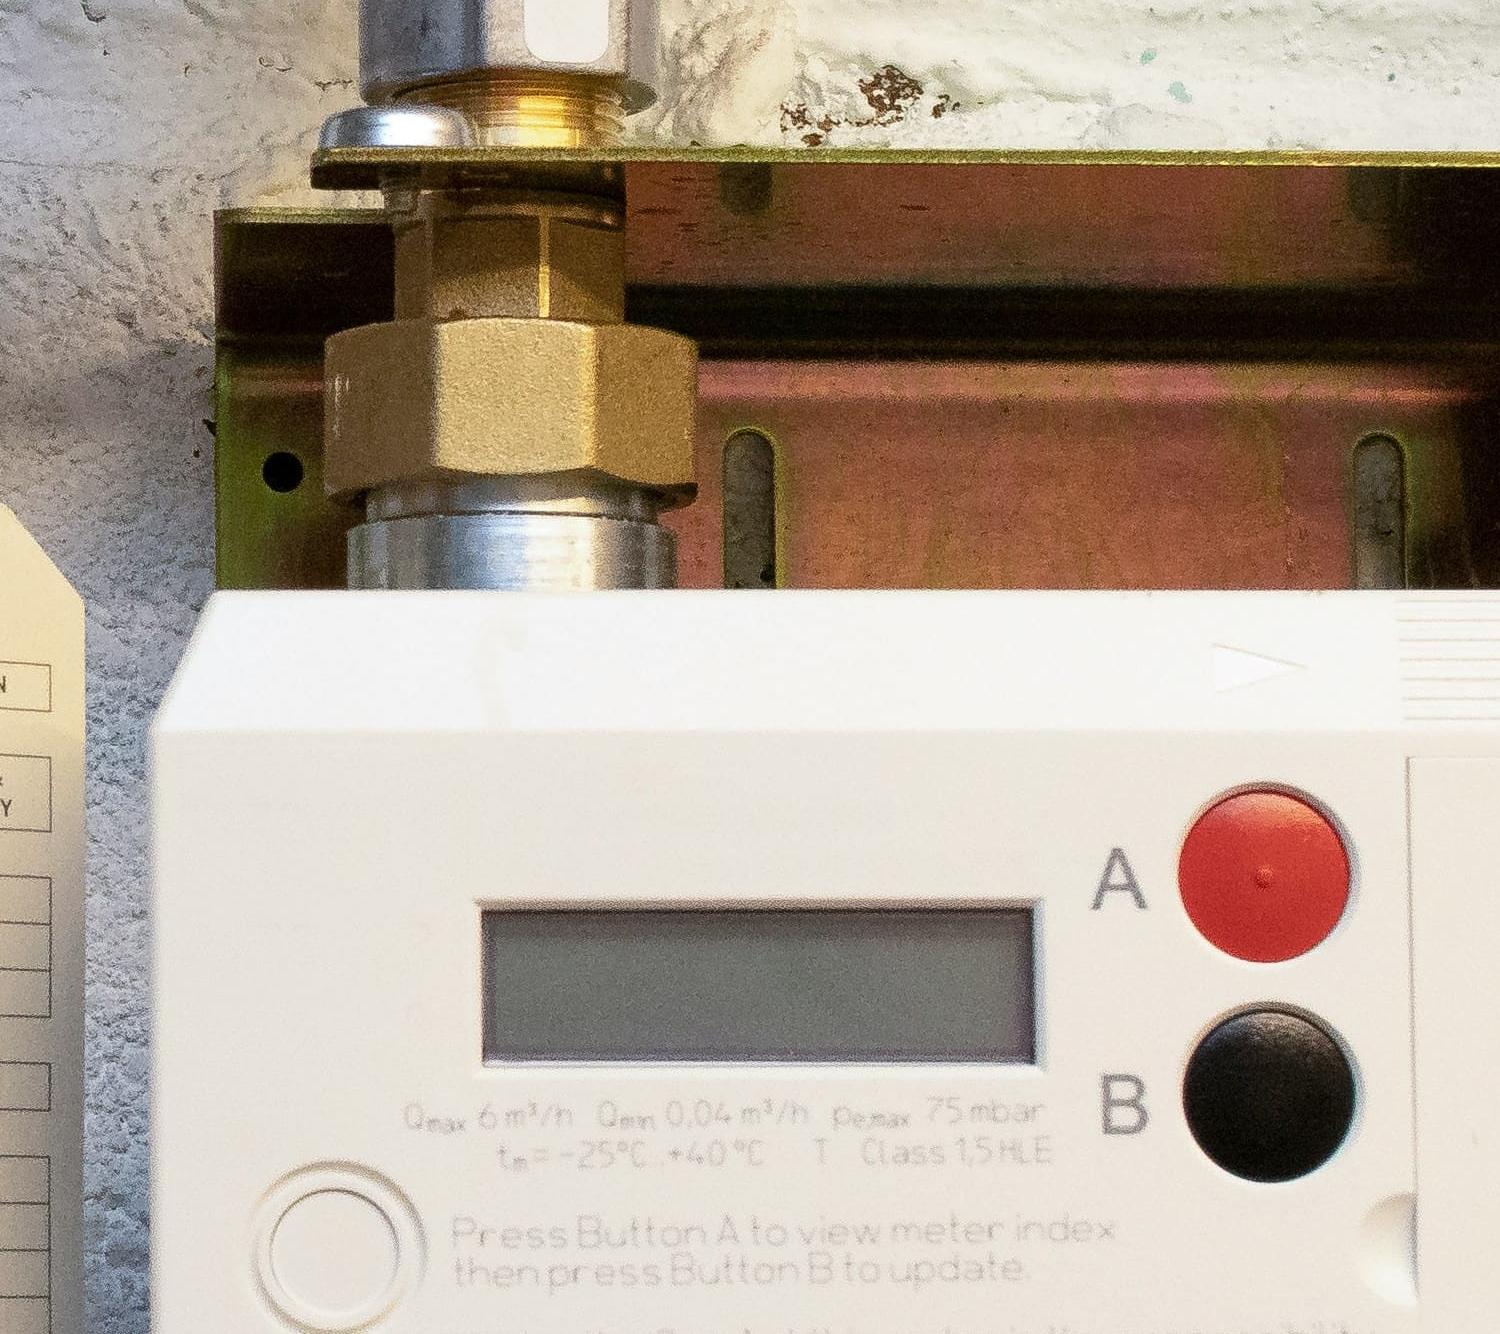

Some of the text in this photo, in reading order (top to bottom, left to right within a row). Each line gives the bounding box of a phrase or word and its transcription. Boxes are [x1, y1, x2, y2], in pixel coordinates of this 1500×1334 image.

[1091, 847, 1147, 911] A
[1101, 1073, 1149, 1136] B
[452, 1212, 1116, 1250] Press Button A to view meter index
[455, 1251, 1031, 1295] then press Button B to update.
